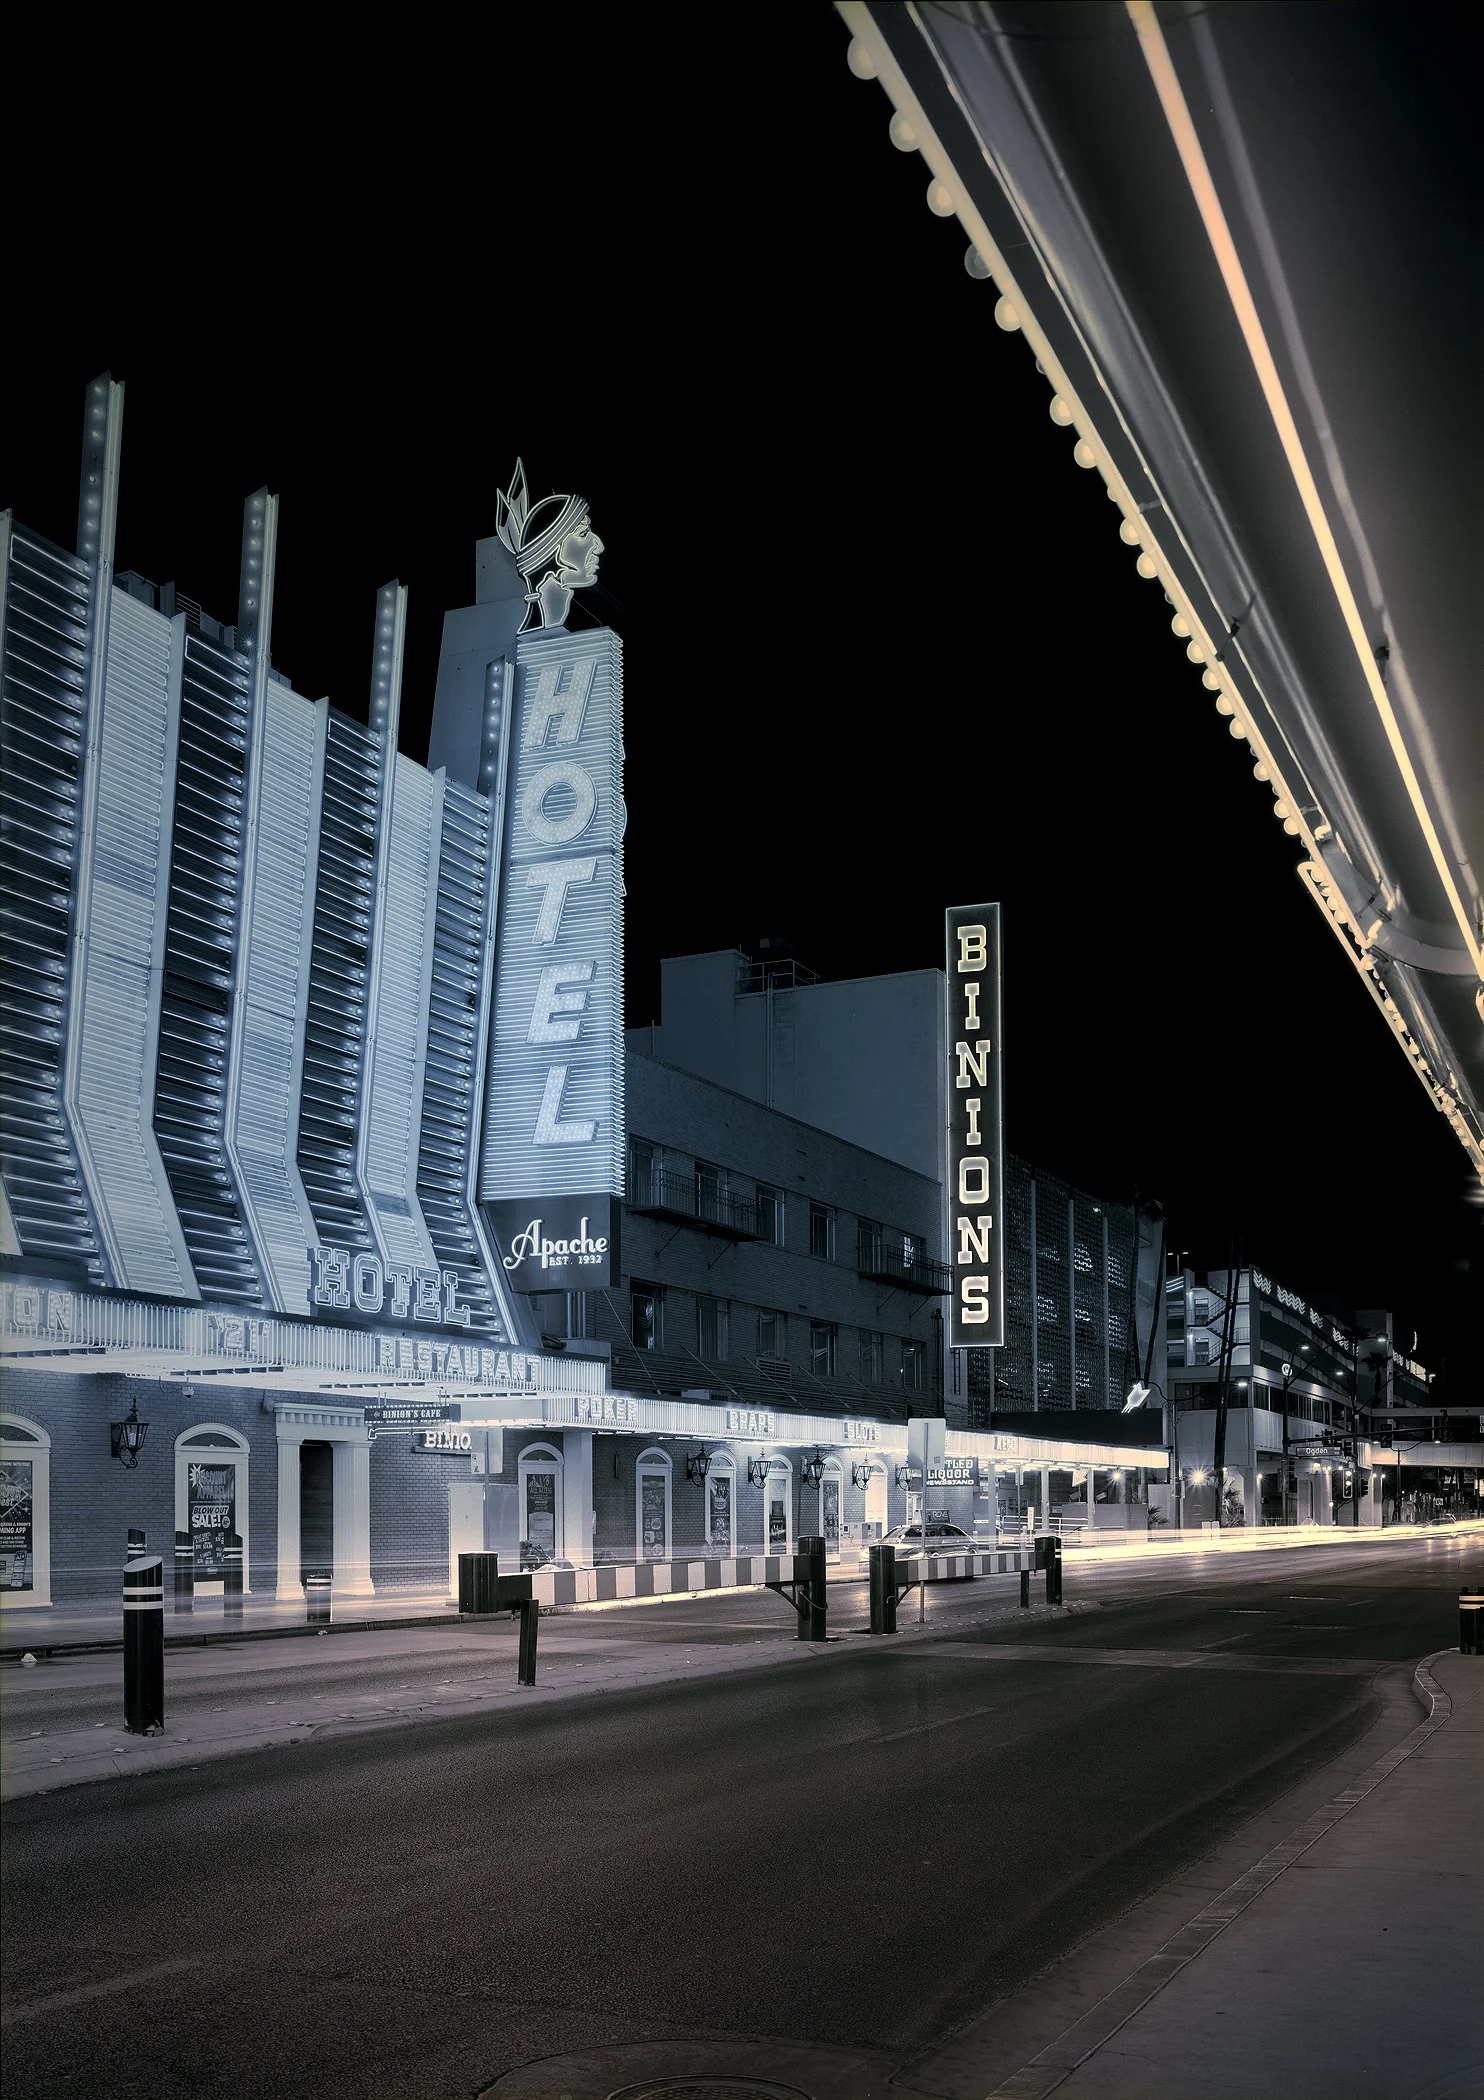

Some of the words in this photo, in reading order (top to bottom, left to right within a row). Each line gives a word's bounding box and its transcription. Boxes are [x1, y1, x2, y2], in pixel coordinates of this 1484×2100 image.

[522, 658, 598, 1147] HOTEL
[956, 925, 992, 1325] BINIONS
[503, 1217, 609, 1269] Apache
[549, 1256, 575, 1266] EST.
[578, 1255, 605, 1264] 1932
[314, 1246, 470, 1326] HOTEL
[380, 1336, 541, 1384] RESTAURANT
[382, 1409, 419, 1419] BINION'S
[420, 1408, 441, 1418] CAFE
[578, 1397, 638, 1422] POKER
[730, 1409, 775, 1432] CRAPS
[424, 1430, 472, 1450] BINIO
[1305, 1447, 1329, 1456] Ogden
[945, 1459, 974, 1468] TLED
[928, 1469, 971, 1481] LIQUOR
[192, 1514, 221, 1528] SALE!
